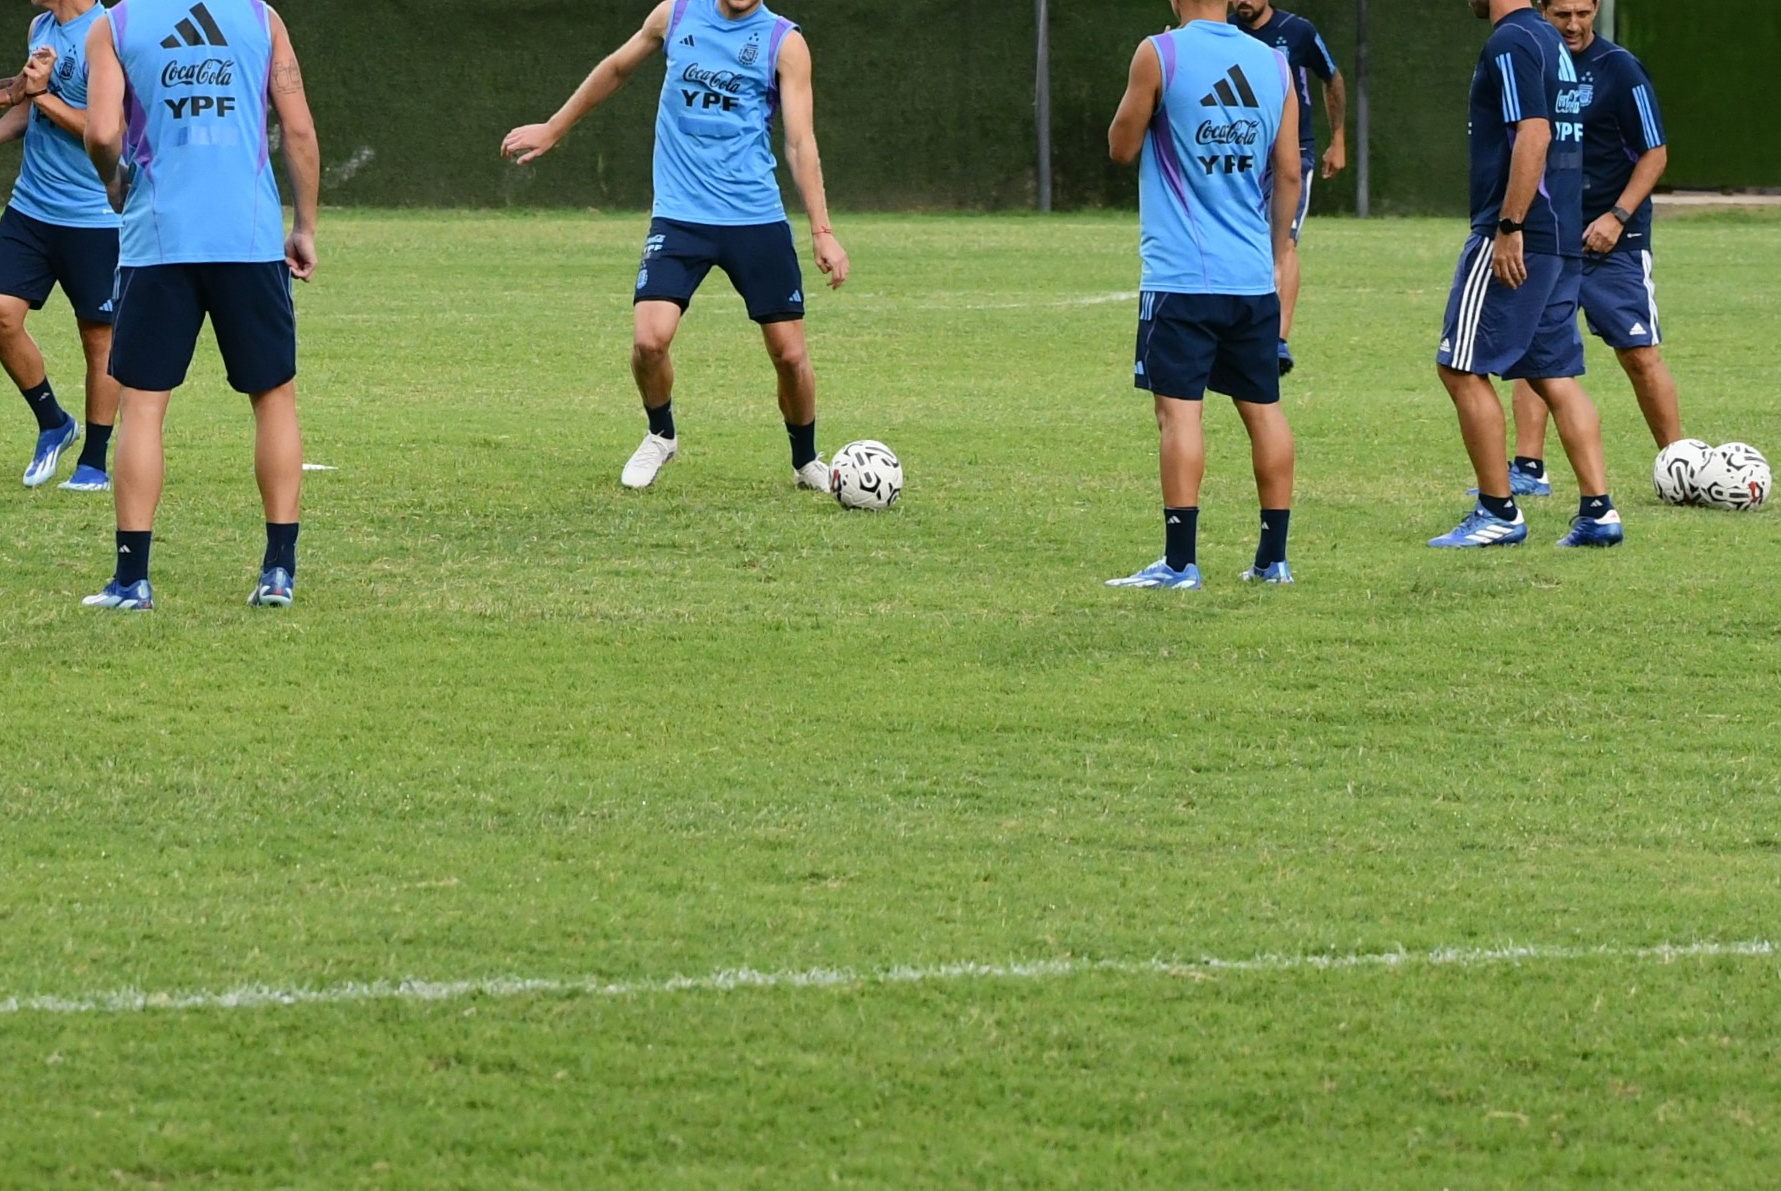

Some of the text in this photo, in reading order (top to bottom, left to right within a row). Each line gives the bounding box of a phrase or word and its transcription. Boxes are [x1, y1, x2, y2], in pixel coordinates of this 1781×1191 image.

[160, 58, 235, 88] Coca-Cola
[683, 62, 745, 93] Coca-Cola
[163, 96, 236, 120] YPF
[681, 88, 740, 112] YPF
